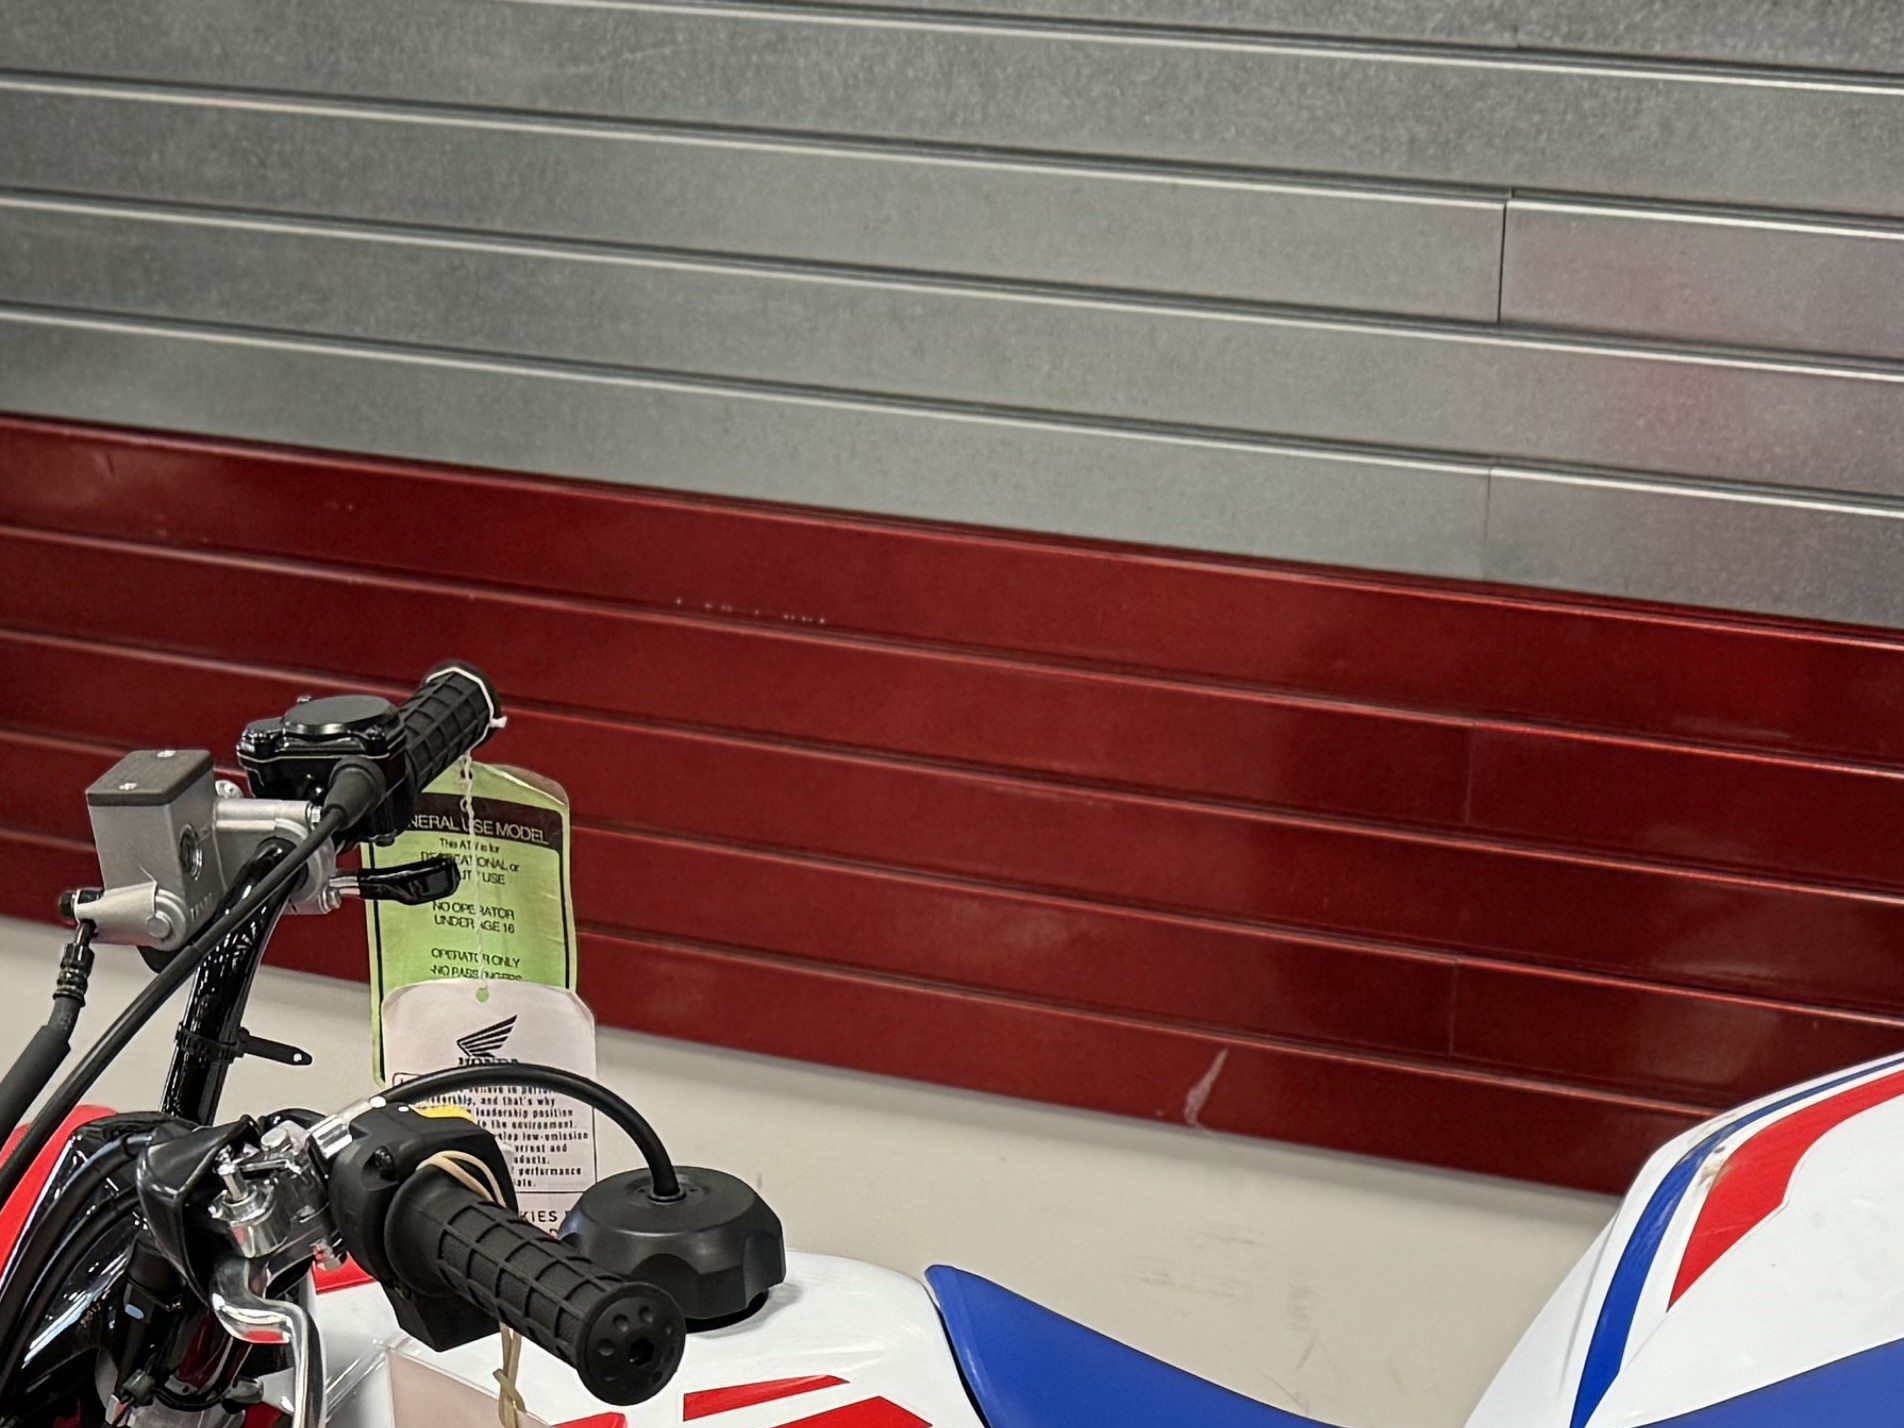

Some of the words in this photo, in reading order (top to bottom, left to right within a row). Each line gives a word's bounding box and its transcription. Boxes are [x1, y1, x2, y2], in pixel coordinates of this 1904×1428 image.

[408, 813, 460, 831] NERAL
[495, 821, 550, 845] MODEL
[482, 871, 507, 885] USE
[432, 900, 450, 912] NO
[434, 914, 475, 930] UNDER
[491, 953, 521, 968] ONLY
[480, 1097, 498, 1106] and
[502, 1096, 533, 1106] that's
[536, 1097, 556, 1108] why
[475, 1108, 529, 1119] leadership
[532, 1108, 574, 1119] position
[490, 1119, 507, 1129] the
[522, 1130, 589, 1141] low-emission
[549, 1143, 567, 1153] and
[517, 1166, 582, 1177] performance
